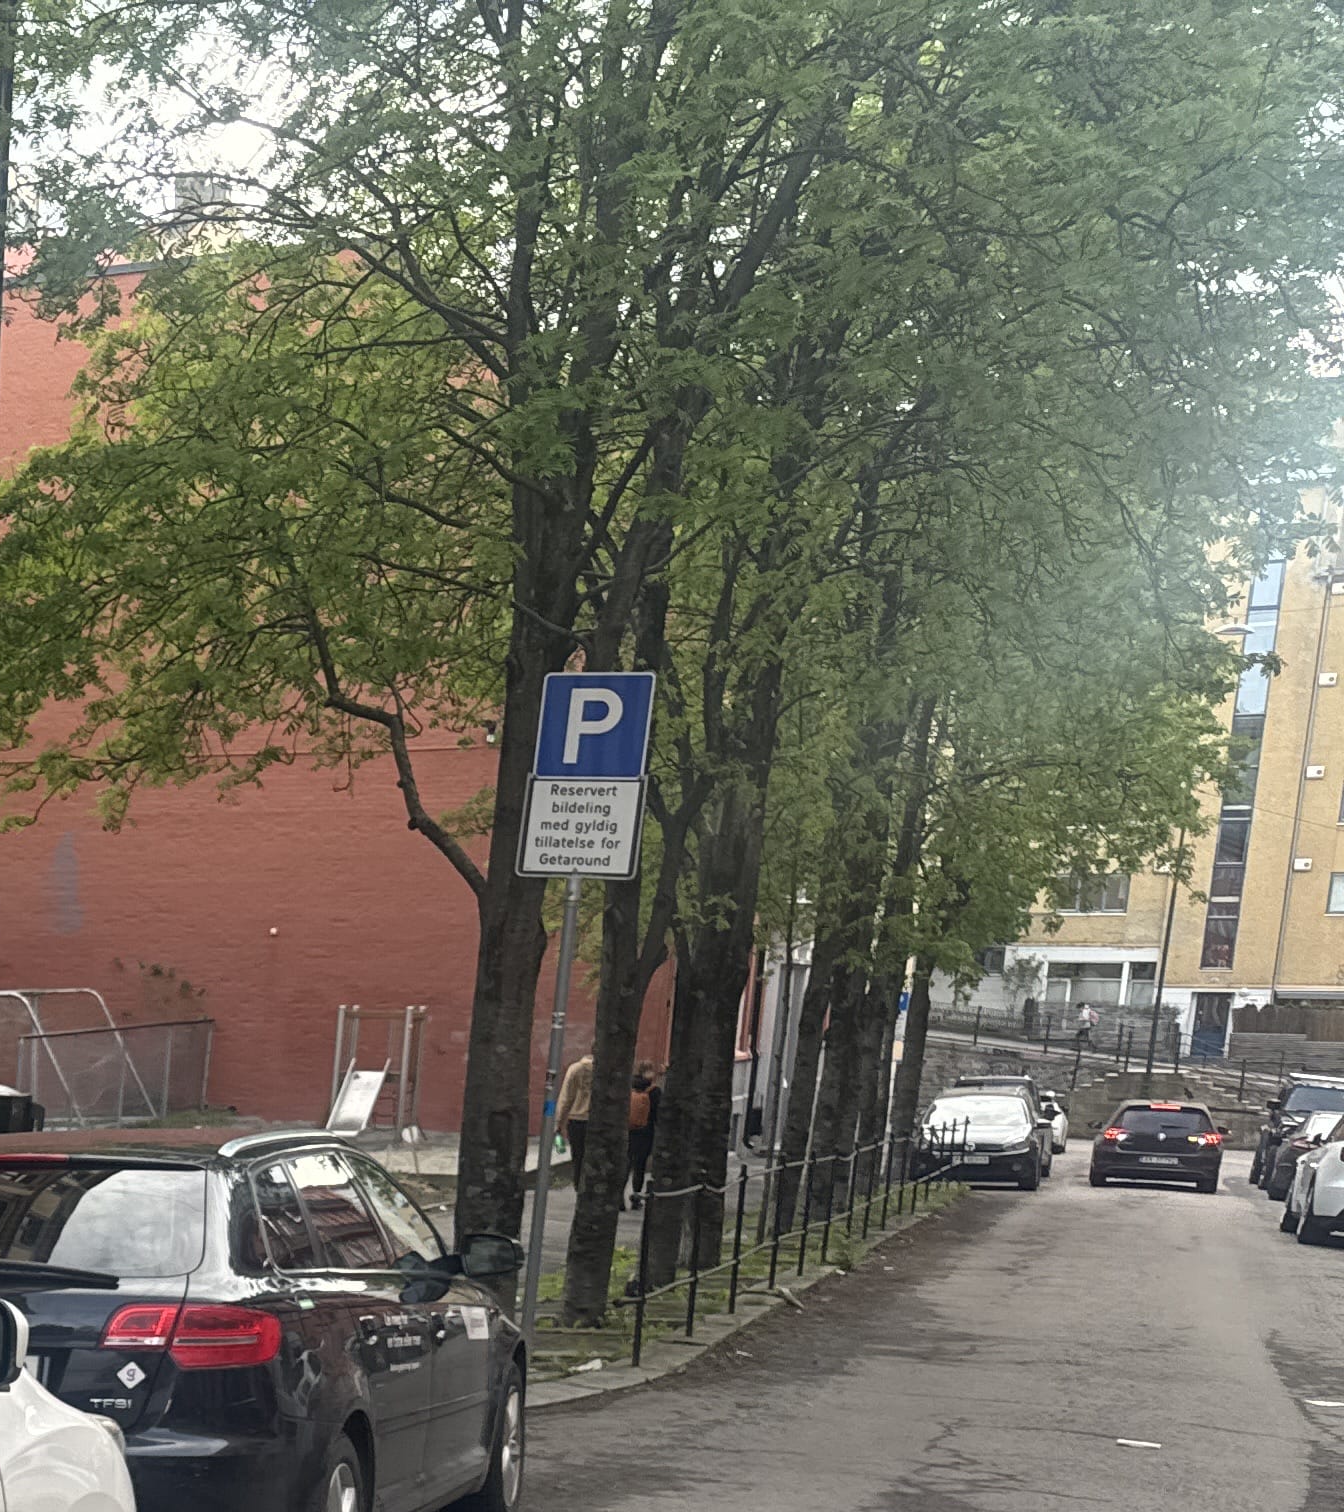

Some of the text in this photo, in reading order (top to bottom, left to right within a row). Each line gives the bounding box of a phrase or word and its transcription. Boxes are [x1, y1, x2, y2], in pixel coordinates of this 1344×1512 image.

[563, 688, 623, 764] P
[550, 783, 618, 797] Reservert
[551, 802, 611, 817] bildeling
[540, 819, 618, 834] med gyldig
[534, 837, 621, 850] tillatelse for
[539, 853, 611, 867] Getaround
[89, 1398, 132, 1409] TFSI
